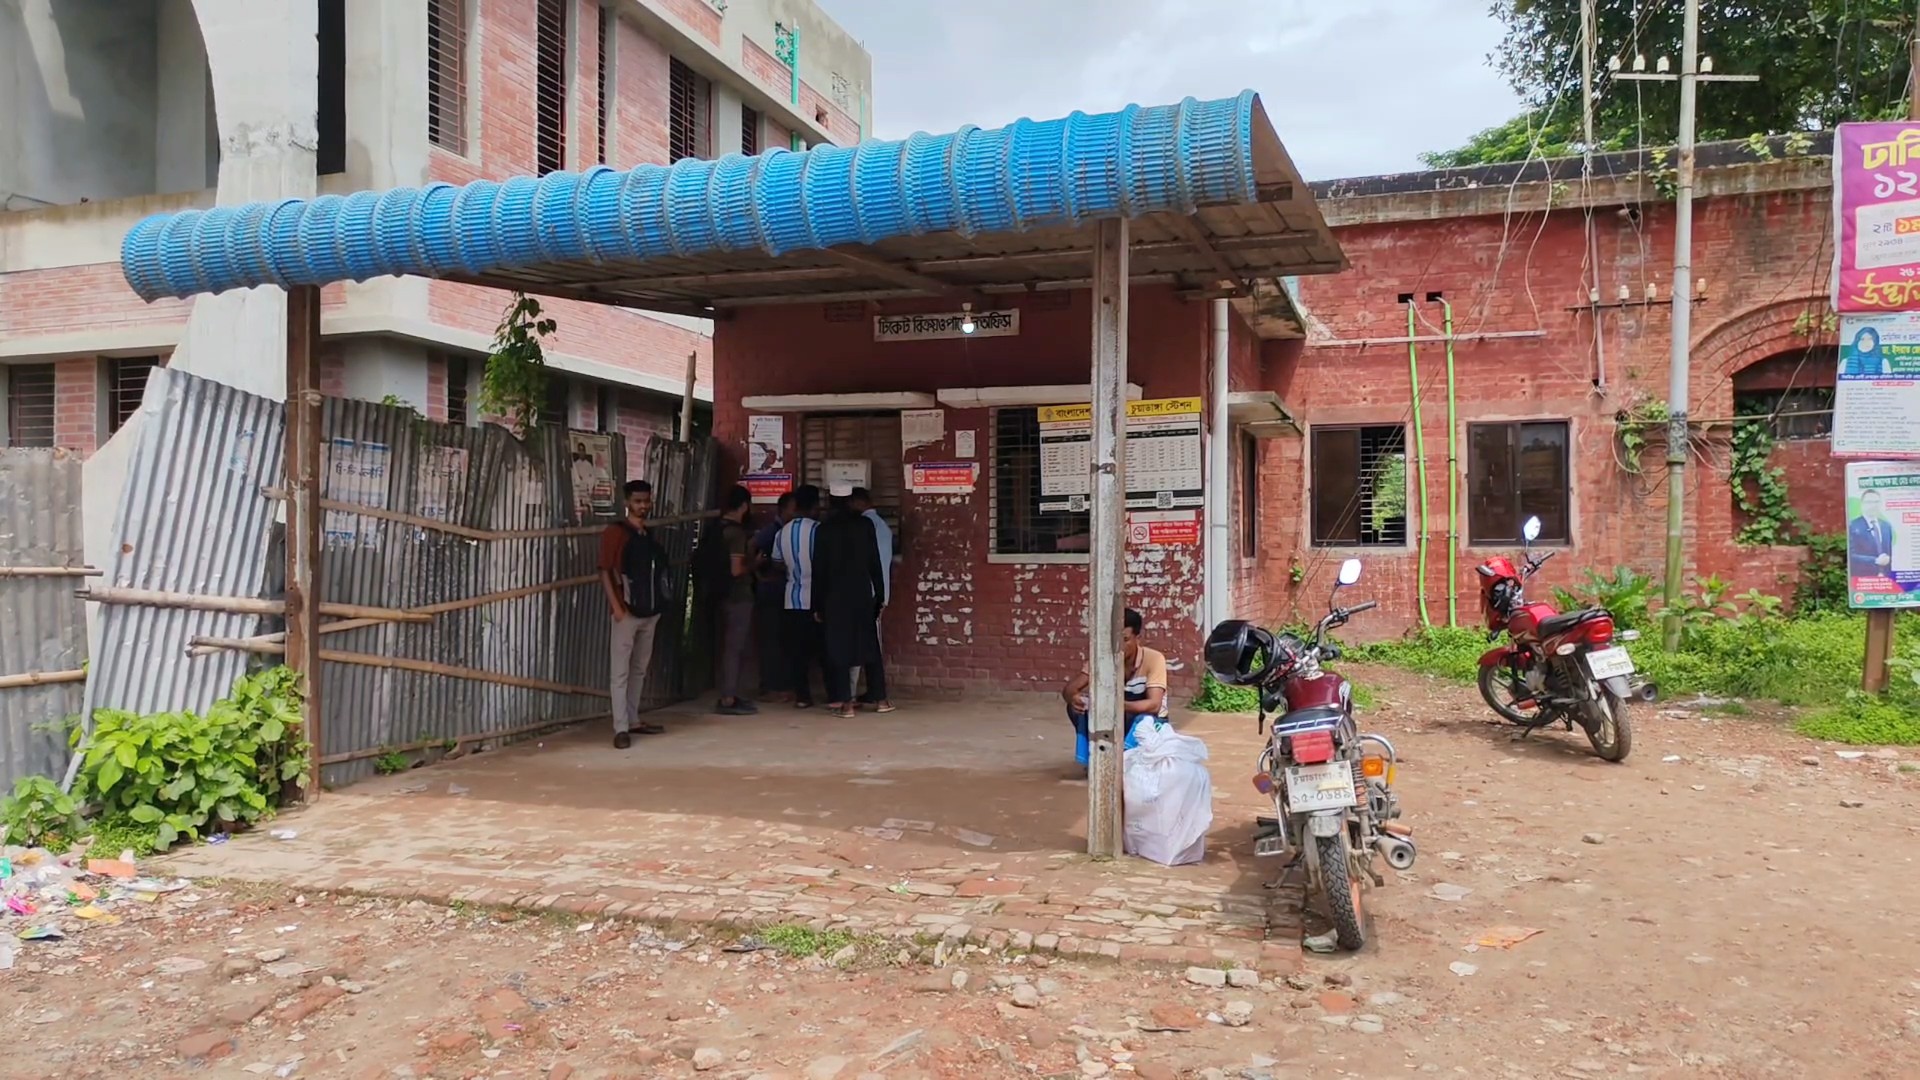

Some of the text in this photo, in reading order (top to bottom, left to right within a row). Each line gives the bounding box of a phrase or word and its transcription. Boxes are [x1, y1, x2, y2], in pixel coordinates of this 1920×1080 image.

[1873, 170, 1918, 198] ১২
[878, 315, 910, 335] টিকেট
[913, 315, 938, 333] বিক্রয়
[978, 311, 1012, 328] অফিস
[1166, 400, 1192, 411] স্টেশন
